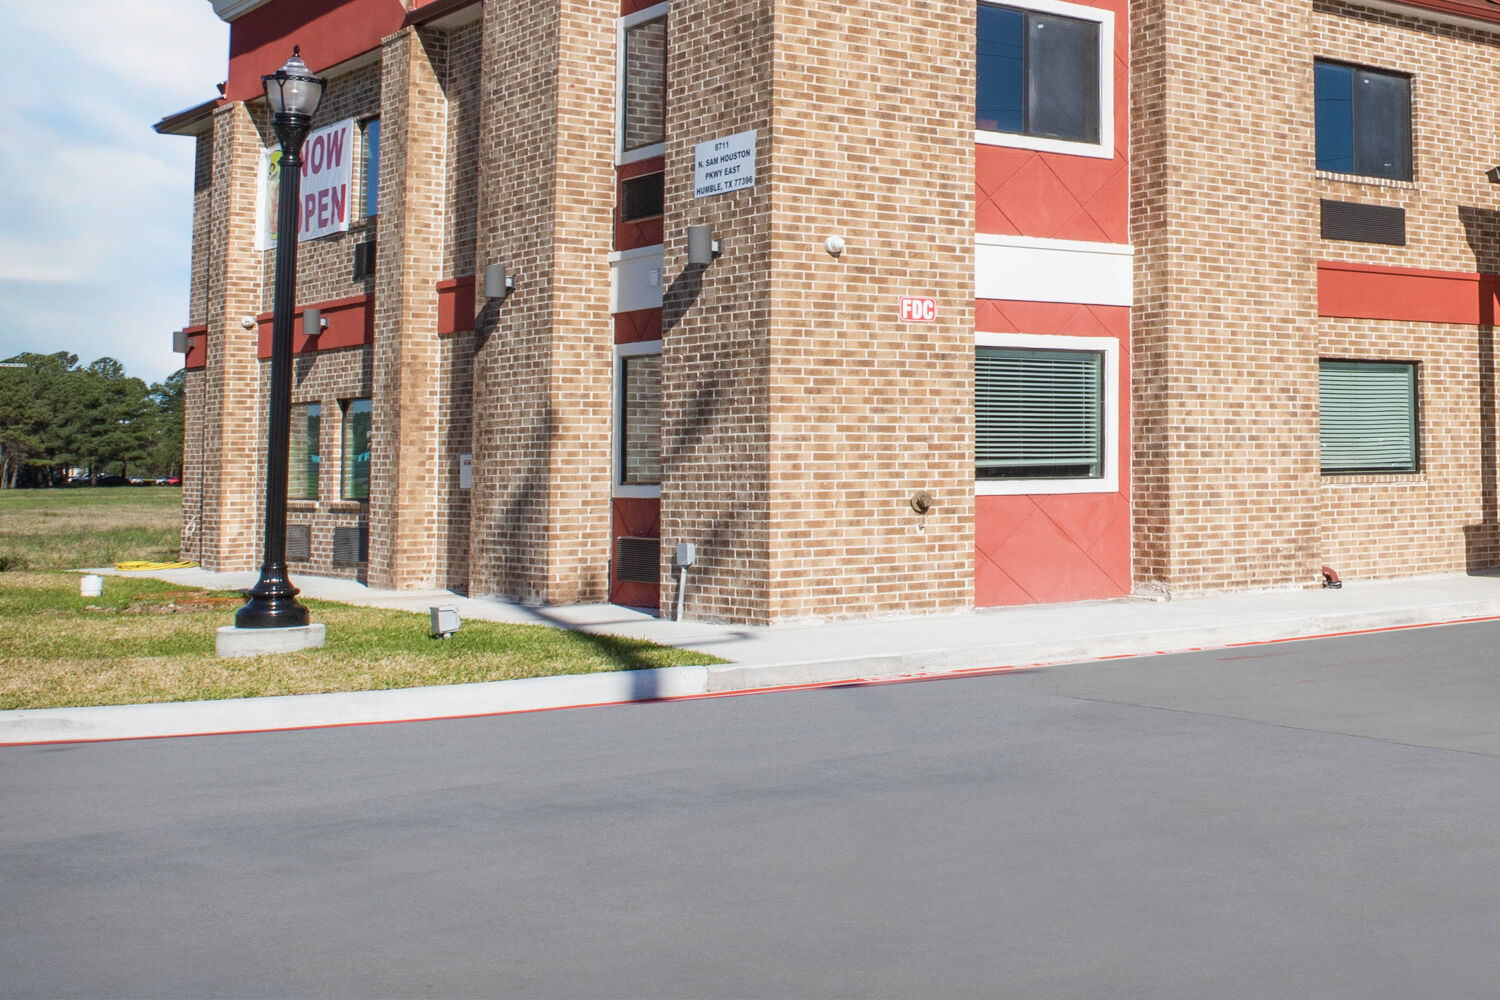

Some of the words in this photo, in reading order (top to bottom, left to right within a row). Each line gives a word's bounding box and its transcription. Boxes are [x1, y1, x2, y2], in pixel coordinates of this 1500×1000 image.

[714, 140, 729, 152] 8711
[705, 156, 719, 167] SAM
[720, 149, 751, 163] HOUSTON
[705, 169, 723, 180] PKWY
[724, 165, 741, 176] EAST
[696, 182, 723, 195] HUMBLE,
[725, 180, 733, 189] TX
[902, 299, 934, 320] FDC
